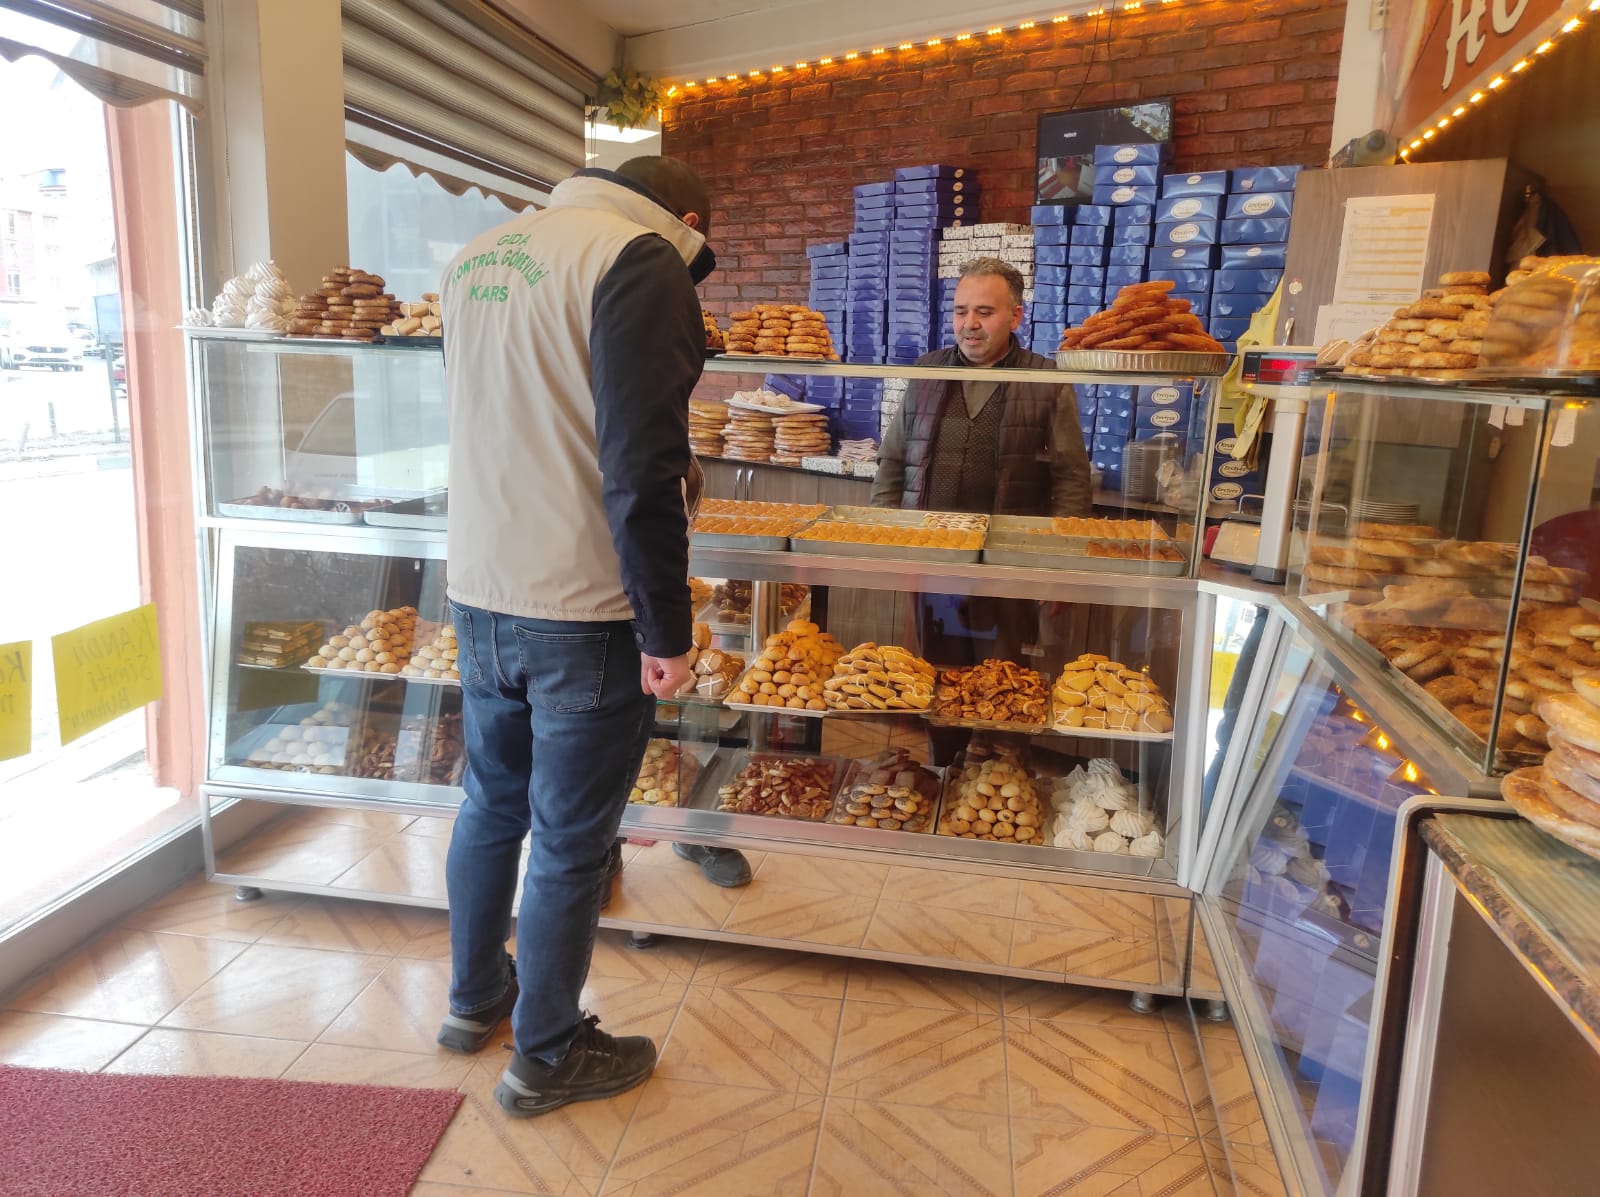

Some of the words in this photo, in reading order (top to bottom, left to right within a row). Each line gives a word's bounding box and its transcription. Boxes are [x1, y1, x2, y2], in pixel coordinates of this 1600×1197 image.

[497, 233, 532, 246] GIDA
[451, 249, 499, 285] KONTROL
[469, 285, 509, 302] KARS
